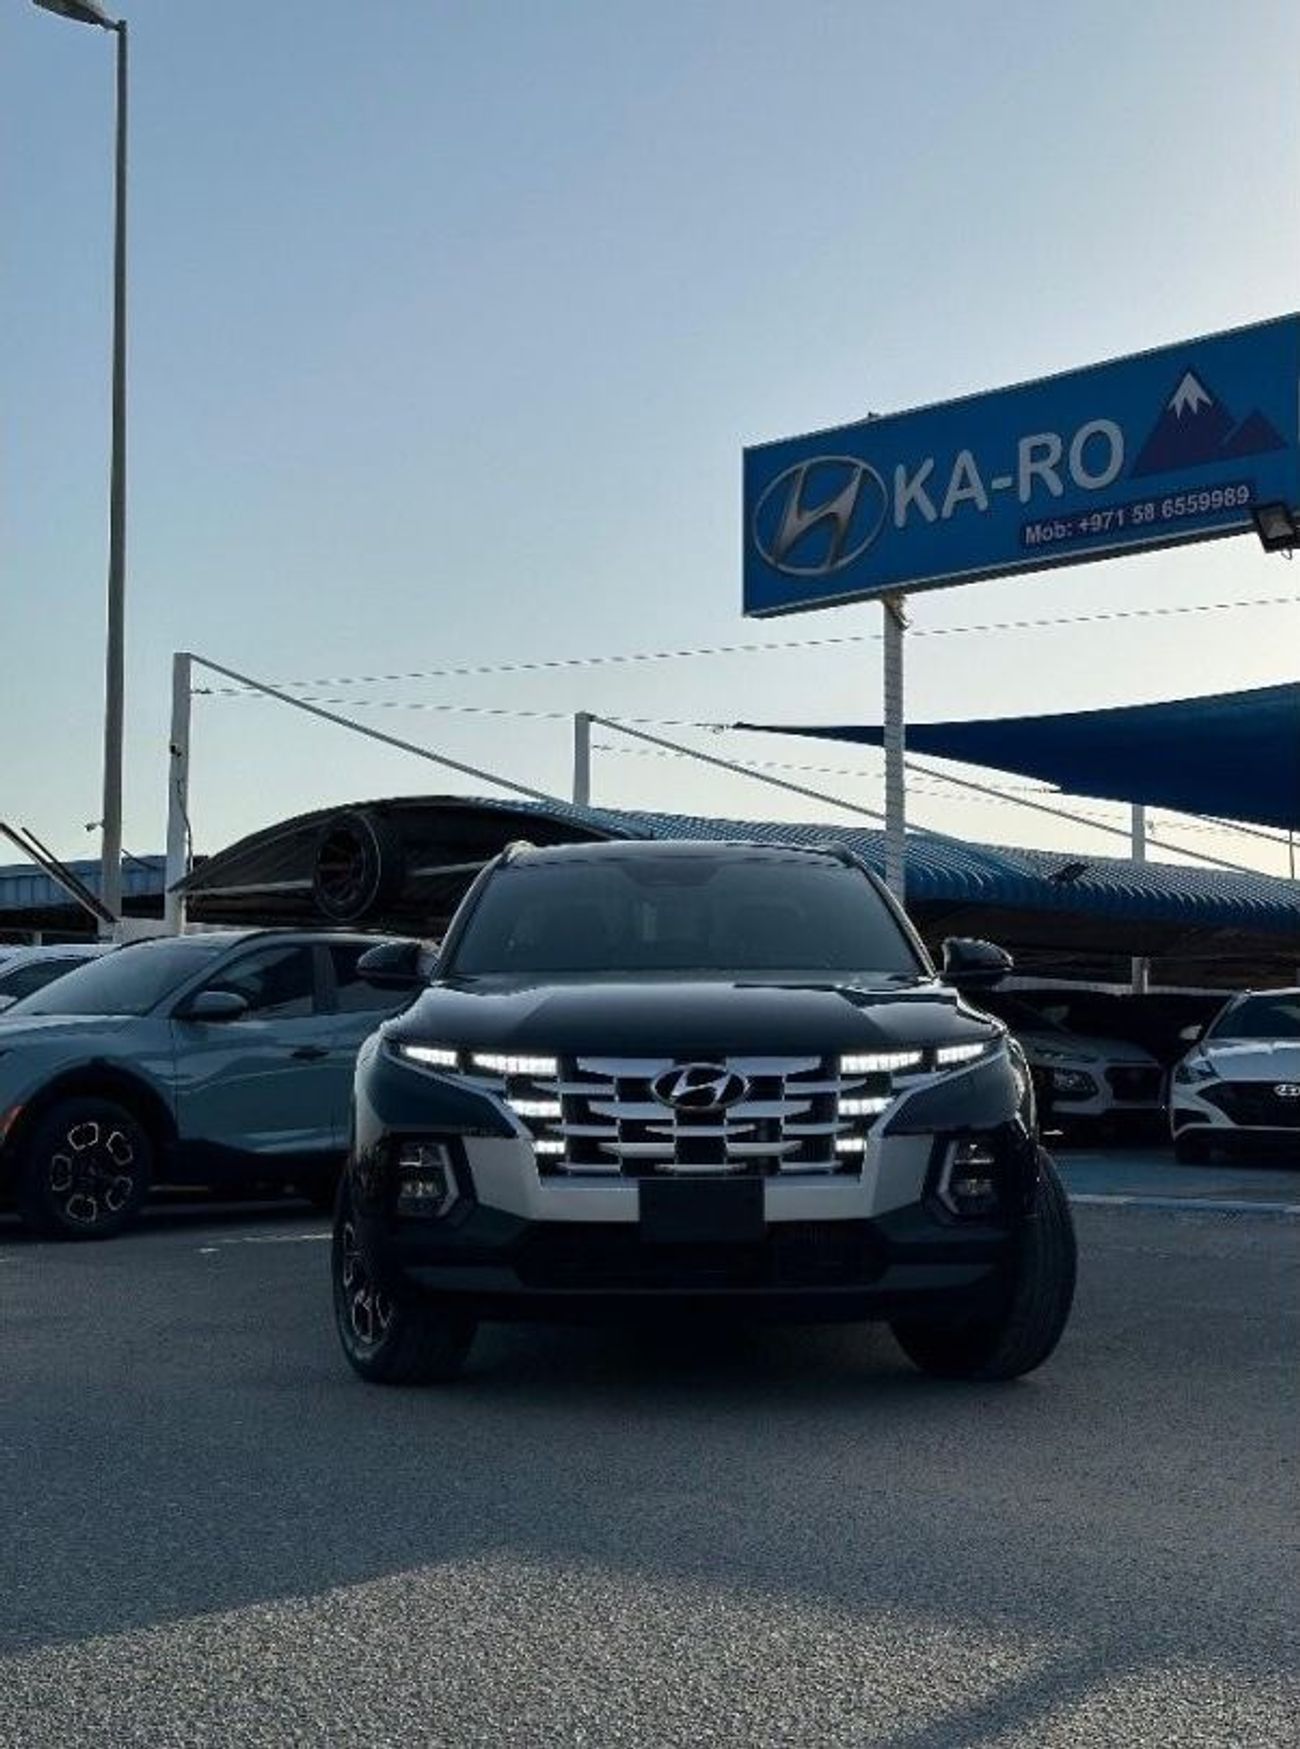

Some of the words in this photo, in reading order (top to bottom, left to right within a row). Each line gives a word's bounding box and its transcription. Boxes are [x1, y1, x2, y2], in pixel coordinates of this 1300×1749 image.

[894, 419, 1124, 528] KA-RO
[1026, 521, 1072, 544] Mob:
[1079, 509, 1124, 533] +971
[1132, 503, 1155, 524] 58
[1162, 485, 1249, 518] 6559989
